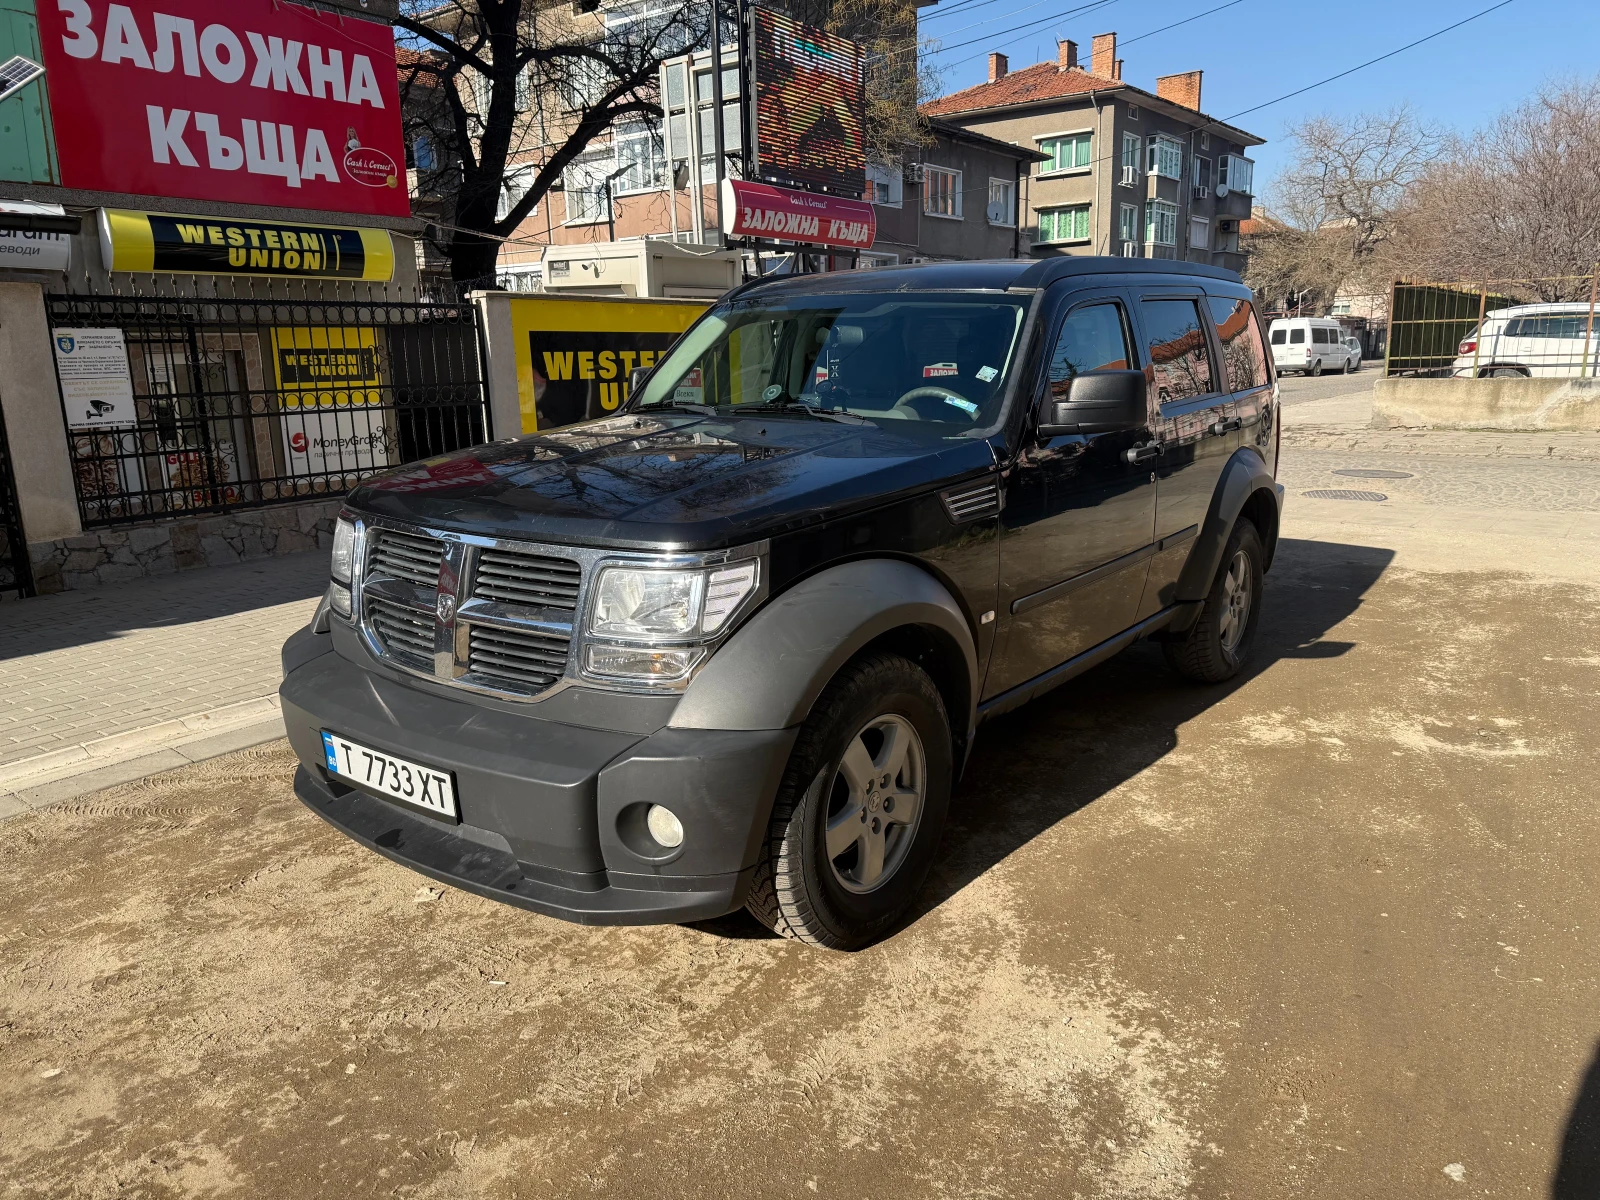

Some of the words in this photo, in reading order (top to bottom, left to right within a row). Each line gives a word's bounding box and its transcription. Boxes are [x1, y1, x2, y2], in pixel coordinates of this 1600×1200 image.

[57, 0, 385, 109] ЗАЛОЖНА
[146, 105, 341, 188] КЪЩА
[347, 157, 362, 168] Cash
[176, 223, 320, 250] WESTERN
[742, 207, 818, 237] ЗАЛОЖНА
[828, 219, 868, 244] КЪЩА
[229, 247, 321, 270] UNION
[285, 354, 357, 366] WESTERN
[309, 364, 358, 376] UNION
[543, 350, 666, 380] WESTE
